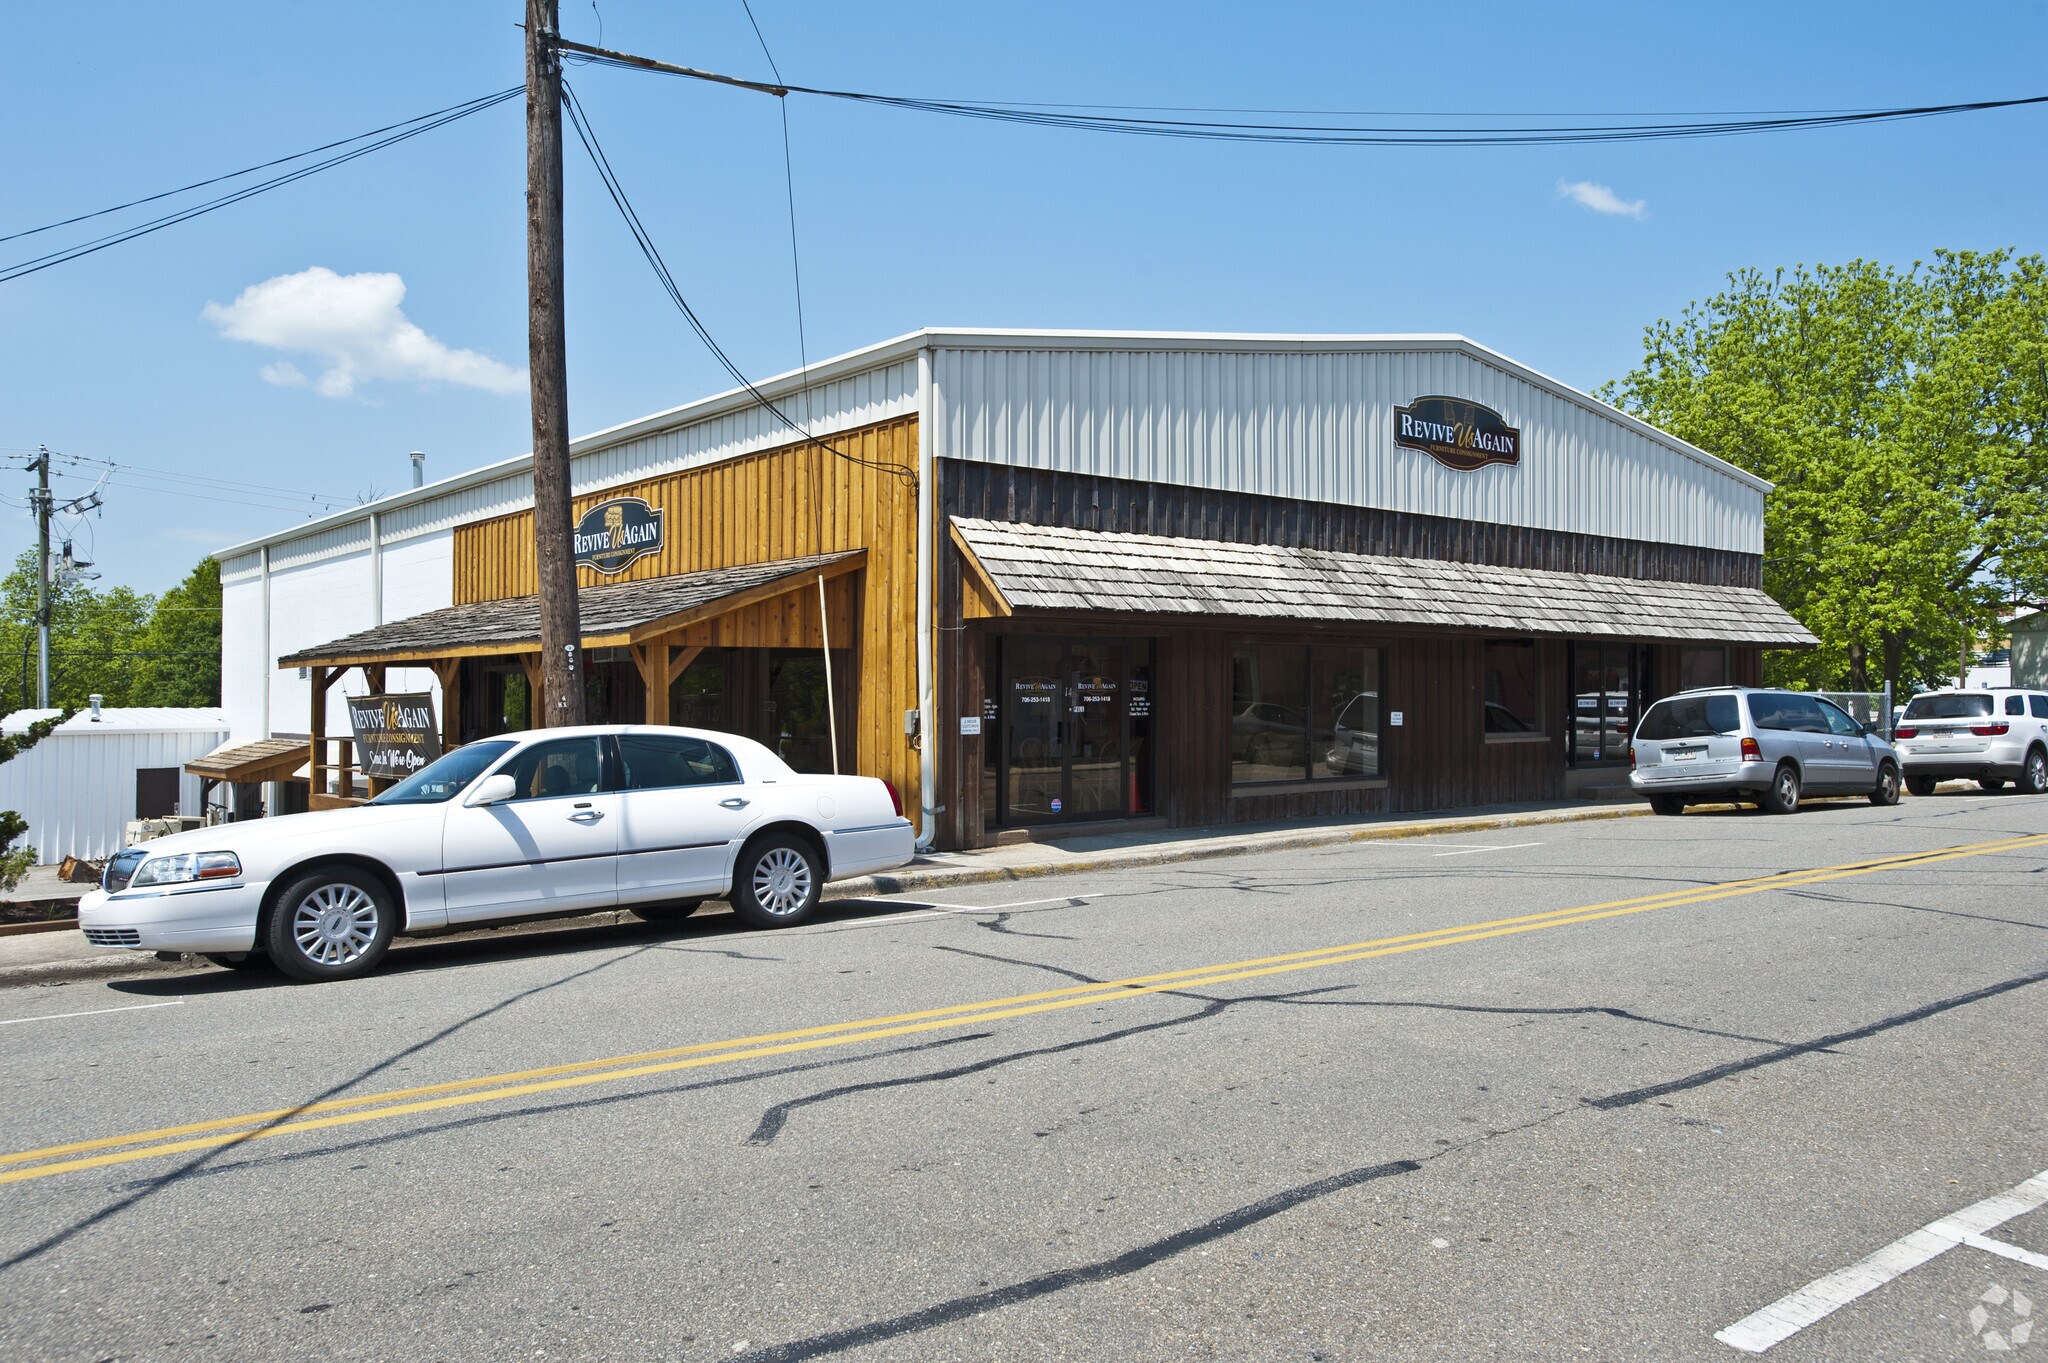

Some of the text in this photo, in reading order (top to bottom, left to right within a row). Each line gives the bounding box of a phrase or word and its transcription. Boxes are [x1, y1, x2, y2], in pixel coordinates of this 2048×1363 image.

[1401, 413, 1514, 454] REVIVE Us AGAIN
[1430, 444, 1488, 460] FURNITURE CONSIGNMENT
[574, 532, 610, 554] REVIVE
[622, 522, 657, 545] AGAIN
[351, 706, 385, 729] REVIVE
[397, 704, 431, 729] AGAIN
